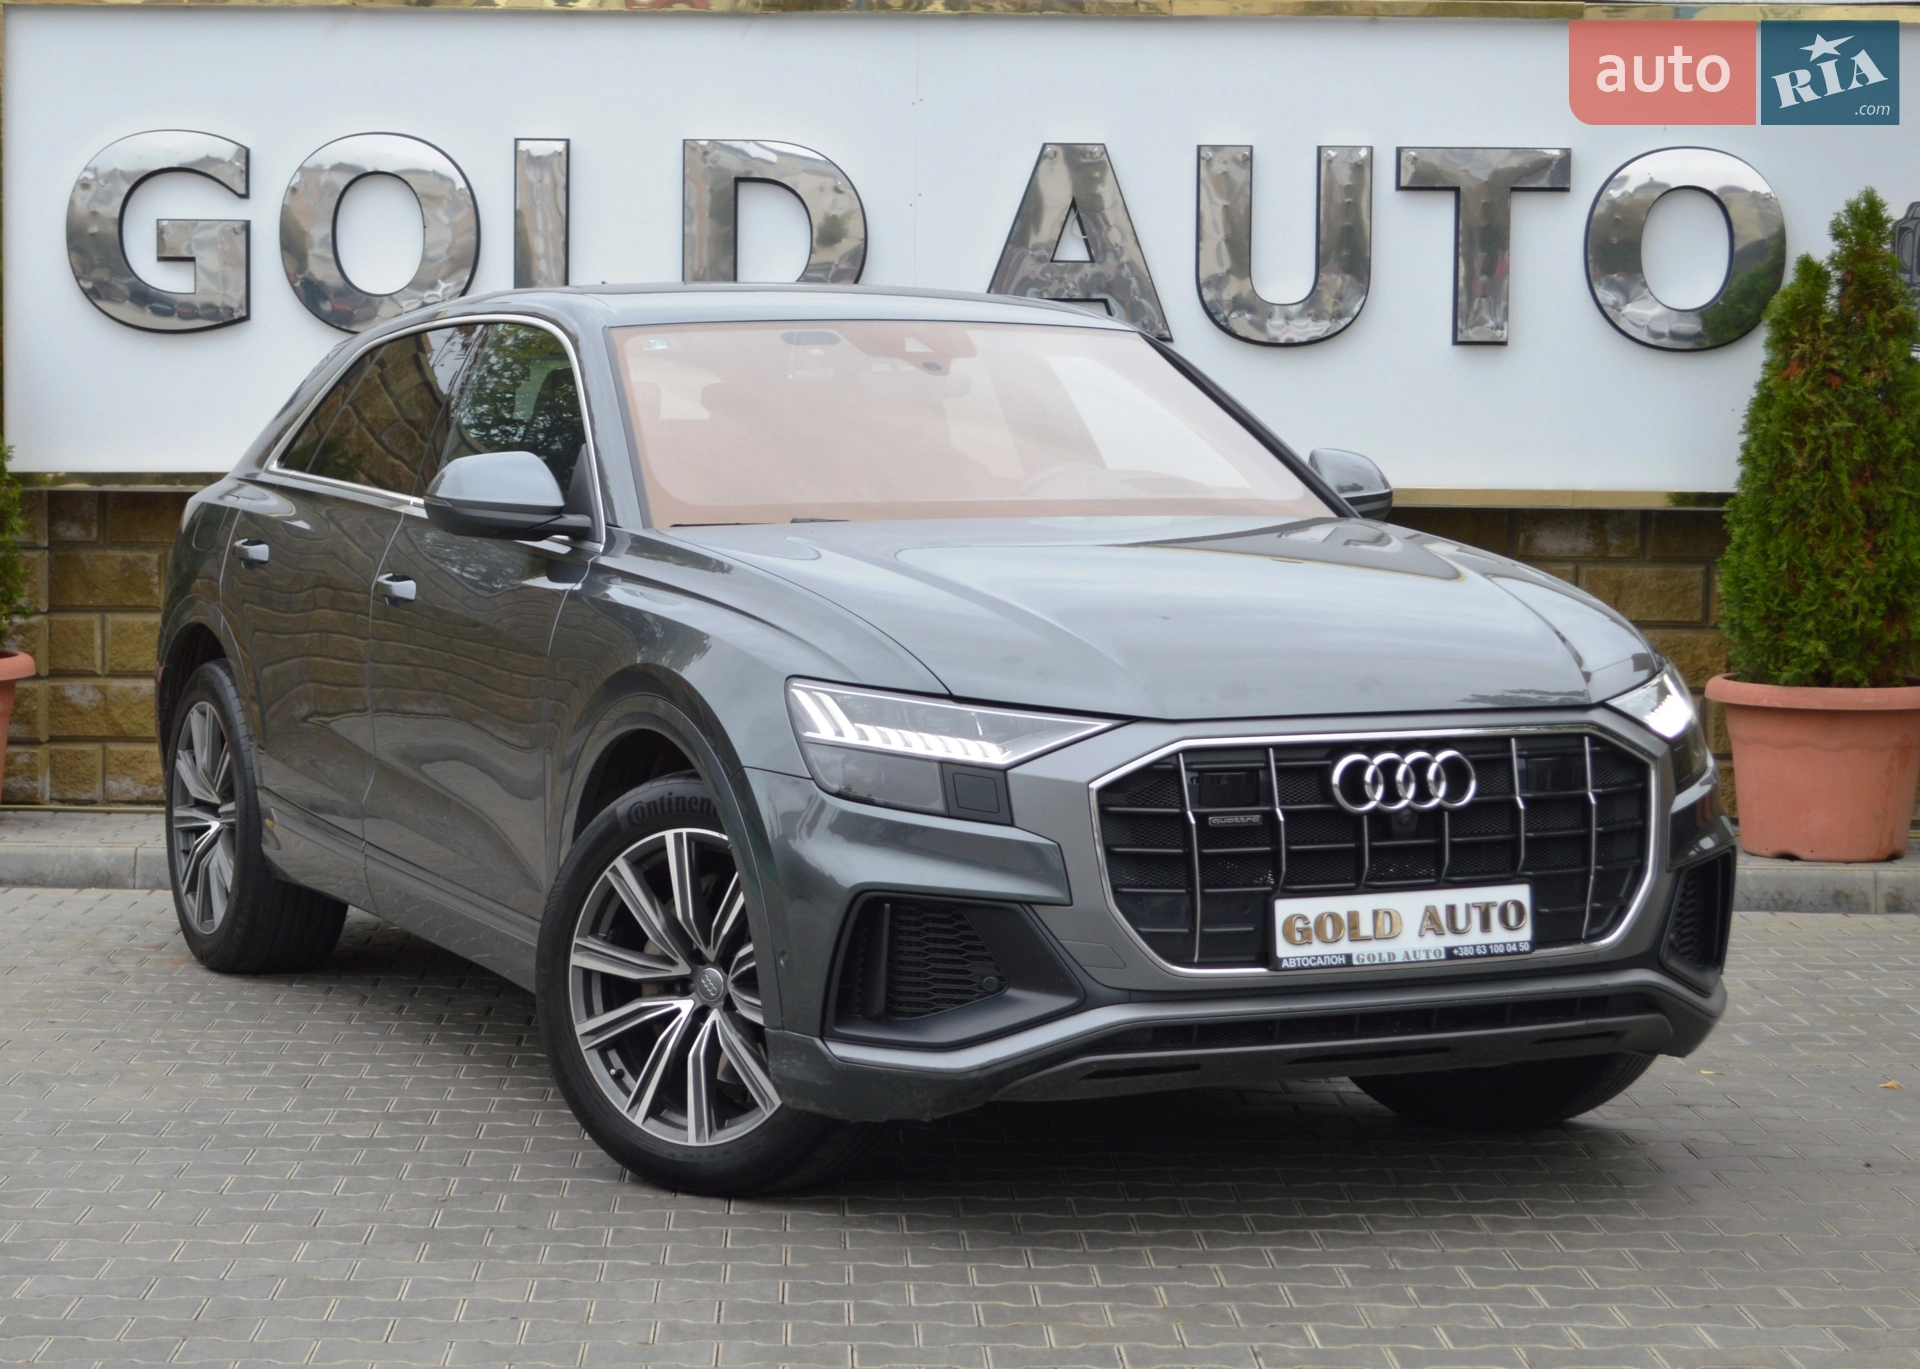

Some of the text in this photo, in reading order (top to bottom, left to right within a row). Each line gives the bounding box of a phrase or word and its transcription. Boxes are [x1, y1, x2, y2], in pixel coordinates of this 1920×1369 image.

[987, 143, 1788, 351] AUTO
[1211, 816, 1260, 825] quattro
[1282, 899, 1527, 945] GOLD AUTO
[1356, 948, 1443, 964] GOLD AUTO
[1452, 941, 1530, 957] +380 63 100 04 50
[1282, 954, 1346, 968] АВТОСАЛОН
